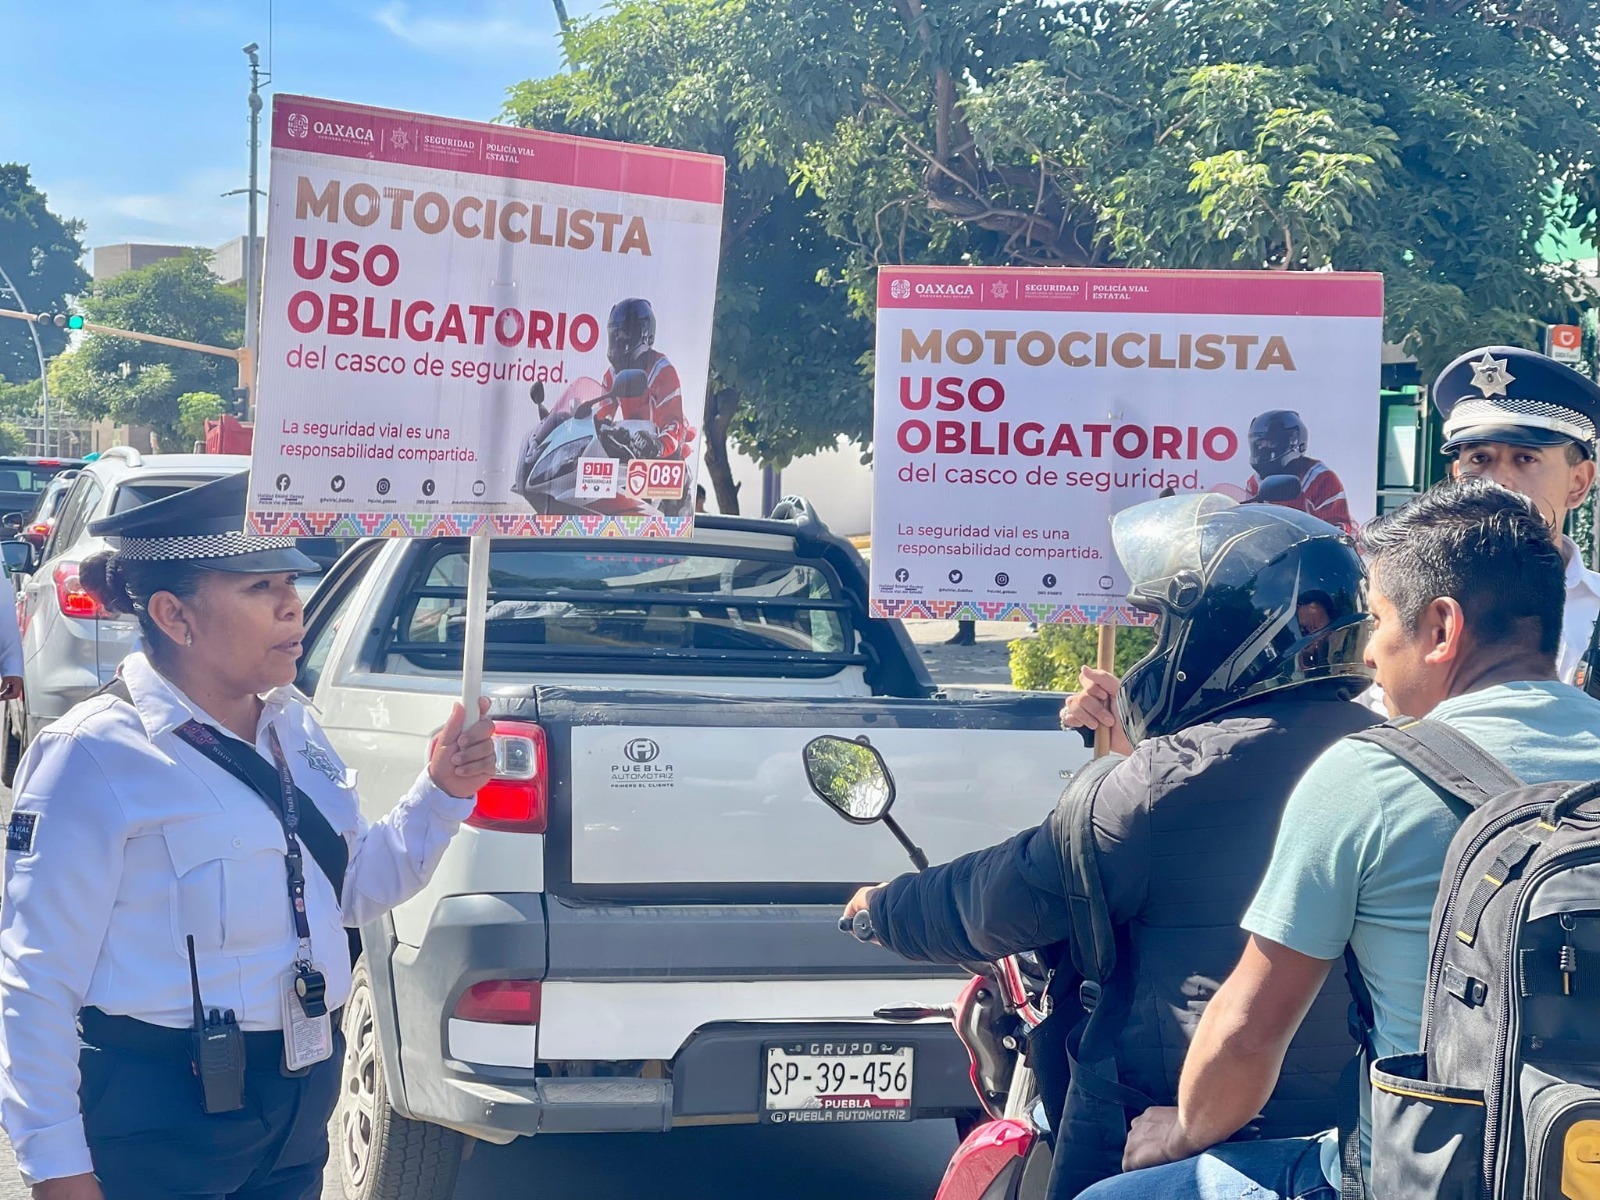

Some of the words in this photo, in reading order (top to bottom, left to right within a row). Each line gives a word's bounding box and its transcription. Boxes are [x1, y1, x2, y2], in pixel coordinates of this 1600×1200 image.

[313, 121, 374, 141] OAXACA
[424, 135, 475, 149] SEGURIDAD
[486, 142, 517, 154] POLICÍA
[518, 147, 535, 156] VIAL
[486, 153, 519, 163] ESTATAL
[296, 176, 652, 257] MOTOCICLISTA
[293, 236, 399, 287] USO
[915, 284, 974, 295] OAXACA
[1025, 284, 1079, 292] SEGURIDAD
[1092, 284, 1127, 292] POLICÍA
[287, 290, 599, 353] OBLIGATORIO
[901, 329, 1297, 371] MOTOCICLISTA
[286, 343, 327, 370] del
[334, 352, 406, 375] casco
[413, 352, 444, 377] de
[451, 357, 568, 385] seguridad.
[900, 377, 1005, 412] USO
[282, 419, 299, 434] La
[303, 420, 375, 439] seguridad
[379, 422, 403, 438] vial
[406, 427, 421, 439] es
[425, 428, 450, 440] una
[897, 419, 1238, 462] OBLIGATORIO
[280, 443, 394, 460] responsabilidad
[397, 446, 478, 464] compartida.
[584, 463, 612, 475] 911
[650, 464, 682, 487] 089
[898, 462, 936, 483] del
[945, 468, 1018, 485] casco
[1026, 465, 1058, 486] de
[1066, 467, 1204, 492] seguridad.
[898, 523, 914, 536] La
[918, 524, 990, 539] seguridad
[994, 526, 1018, 538] vial
[1022, 529, 1039, 539] es
[1042, 530, 1070, 540] una
[897, 543, 1010, 557] responsabilidad
[1015, 546, 1103, 560] compartida.
[611, 764, 673, 772] PUEBLA
[810, 1043, 873, 1055] GRUPO
[769, 1061, 908, 1096] SP-39-456
[824, 1099, 872, 1109] PUEBLA
[788, 1111, 833, 1122] PUEBLA
[836, 1109, 906, 1121] AUTOMOTRIZ
